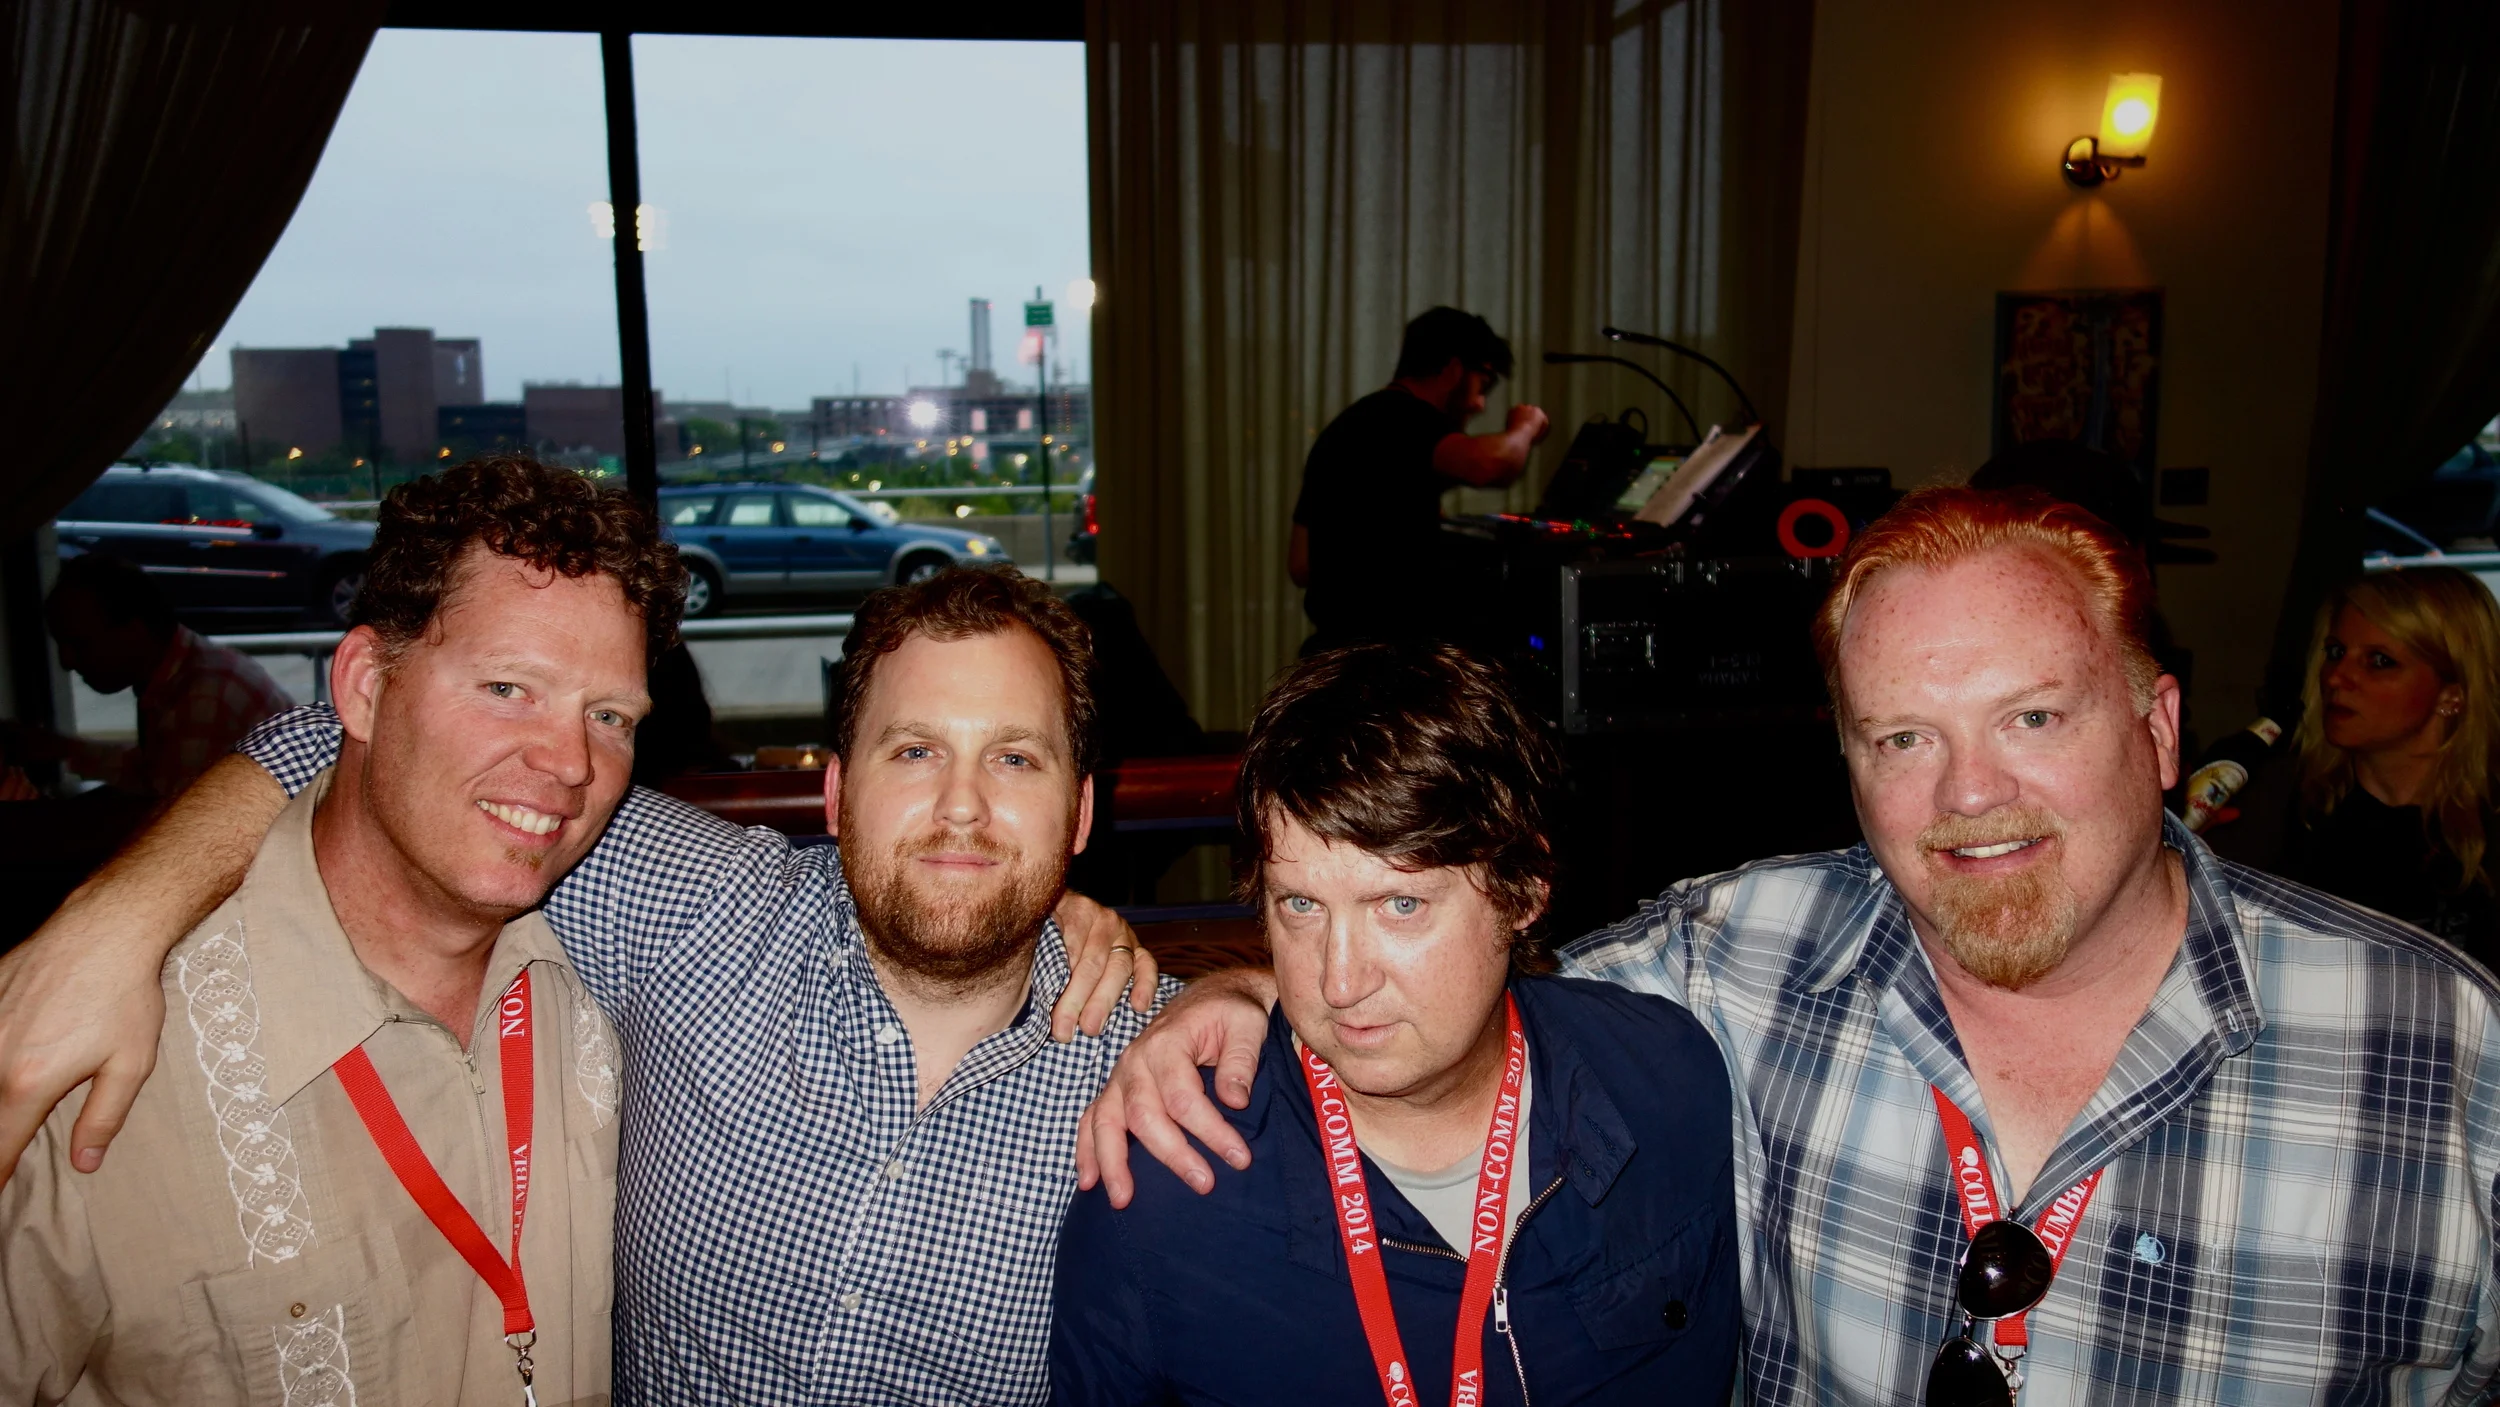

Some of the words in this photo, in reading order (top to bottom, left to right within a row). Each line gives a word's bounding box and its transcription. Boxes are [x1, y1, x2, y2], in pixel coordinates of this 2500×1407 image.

[1307, 1048, 1361, 1188] ON-COMM
[1340, 1193, 1374, 1256] 2014
[1474, 1091, 1517, 1257] NON-COMM
[1506, 1029, 1523, 1087] 2014
